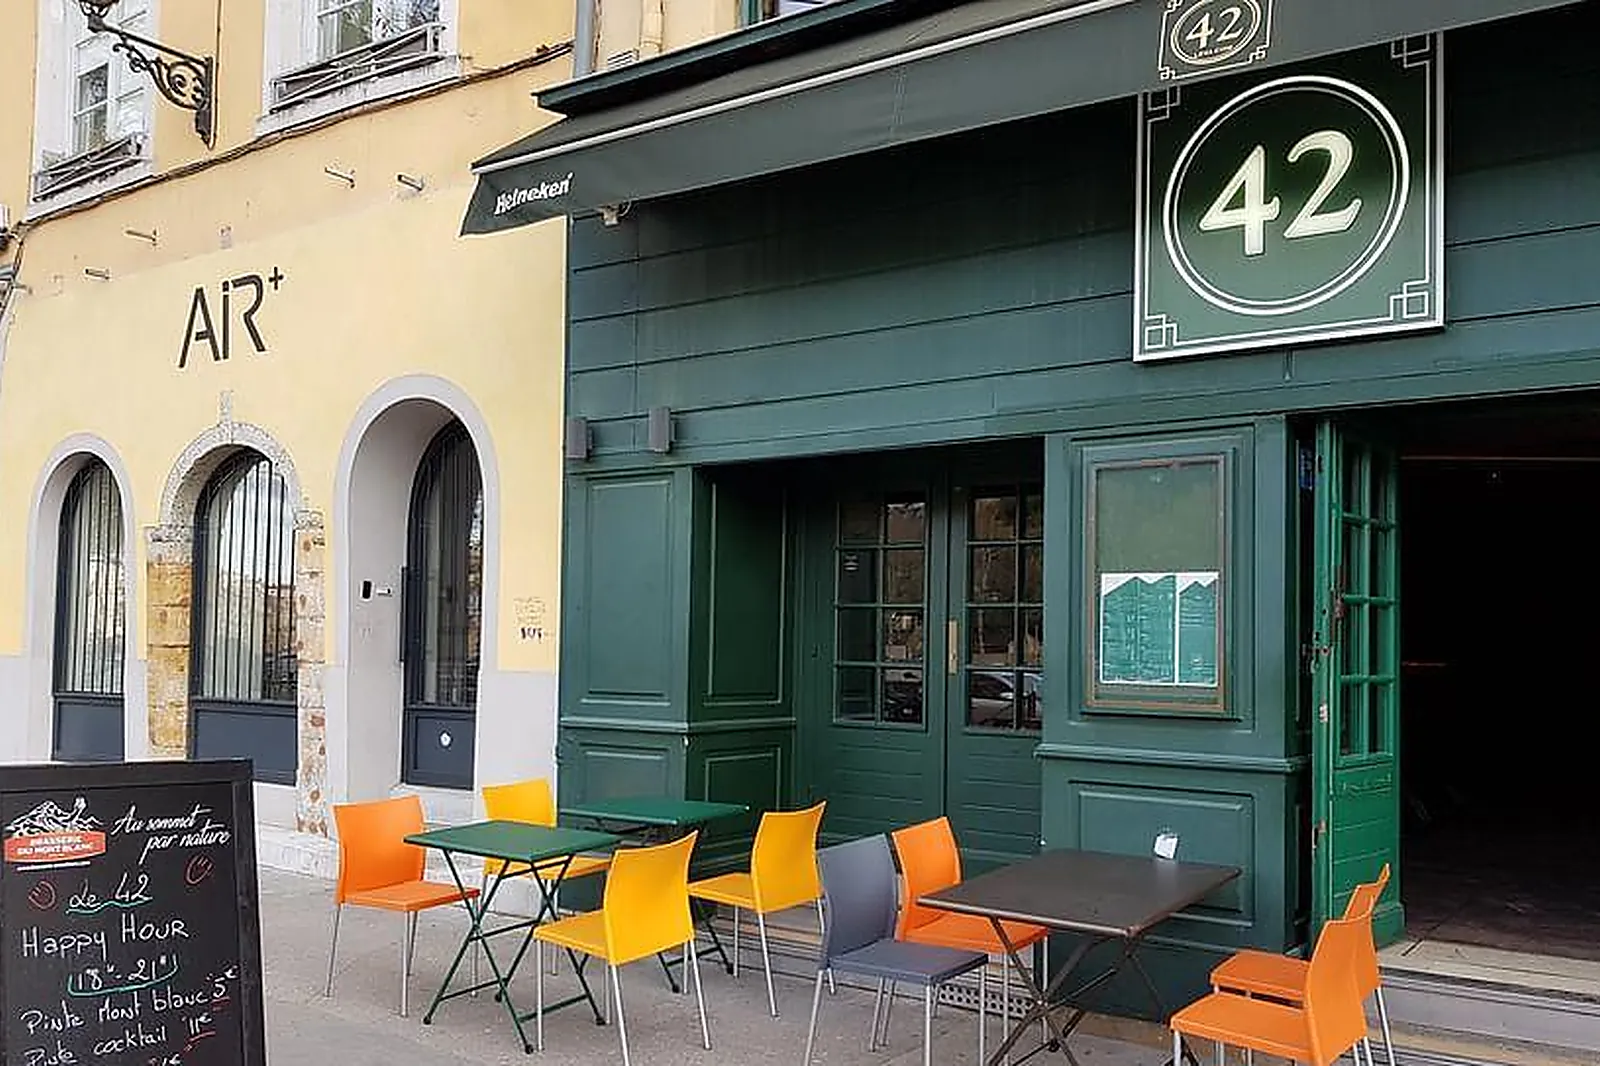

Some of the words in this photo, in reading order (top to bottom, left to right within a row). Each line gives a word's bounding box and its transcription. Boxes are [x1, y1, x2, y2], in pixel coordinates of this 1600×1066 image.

[1185, 6, 1244, 49] 42
[494, 172, 573, 215] Heineken
[1199, 129, 1362, 256] 42
[110, 804, 146, 836] Au
[146, 803, 212, 831] sommet
[138, 833, 179, 866] par
[179, 818, 232, 848] nature
[115, 871, 154, 902] 42
[21, 926, 108, 962] Happy
[93, 1022, 168, 1056] cocktail
